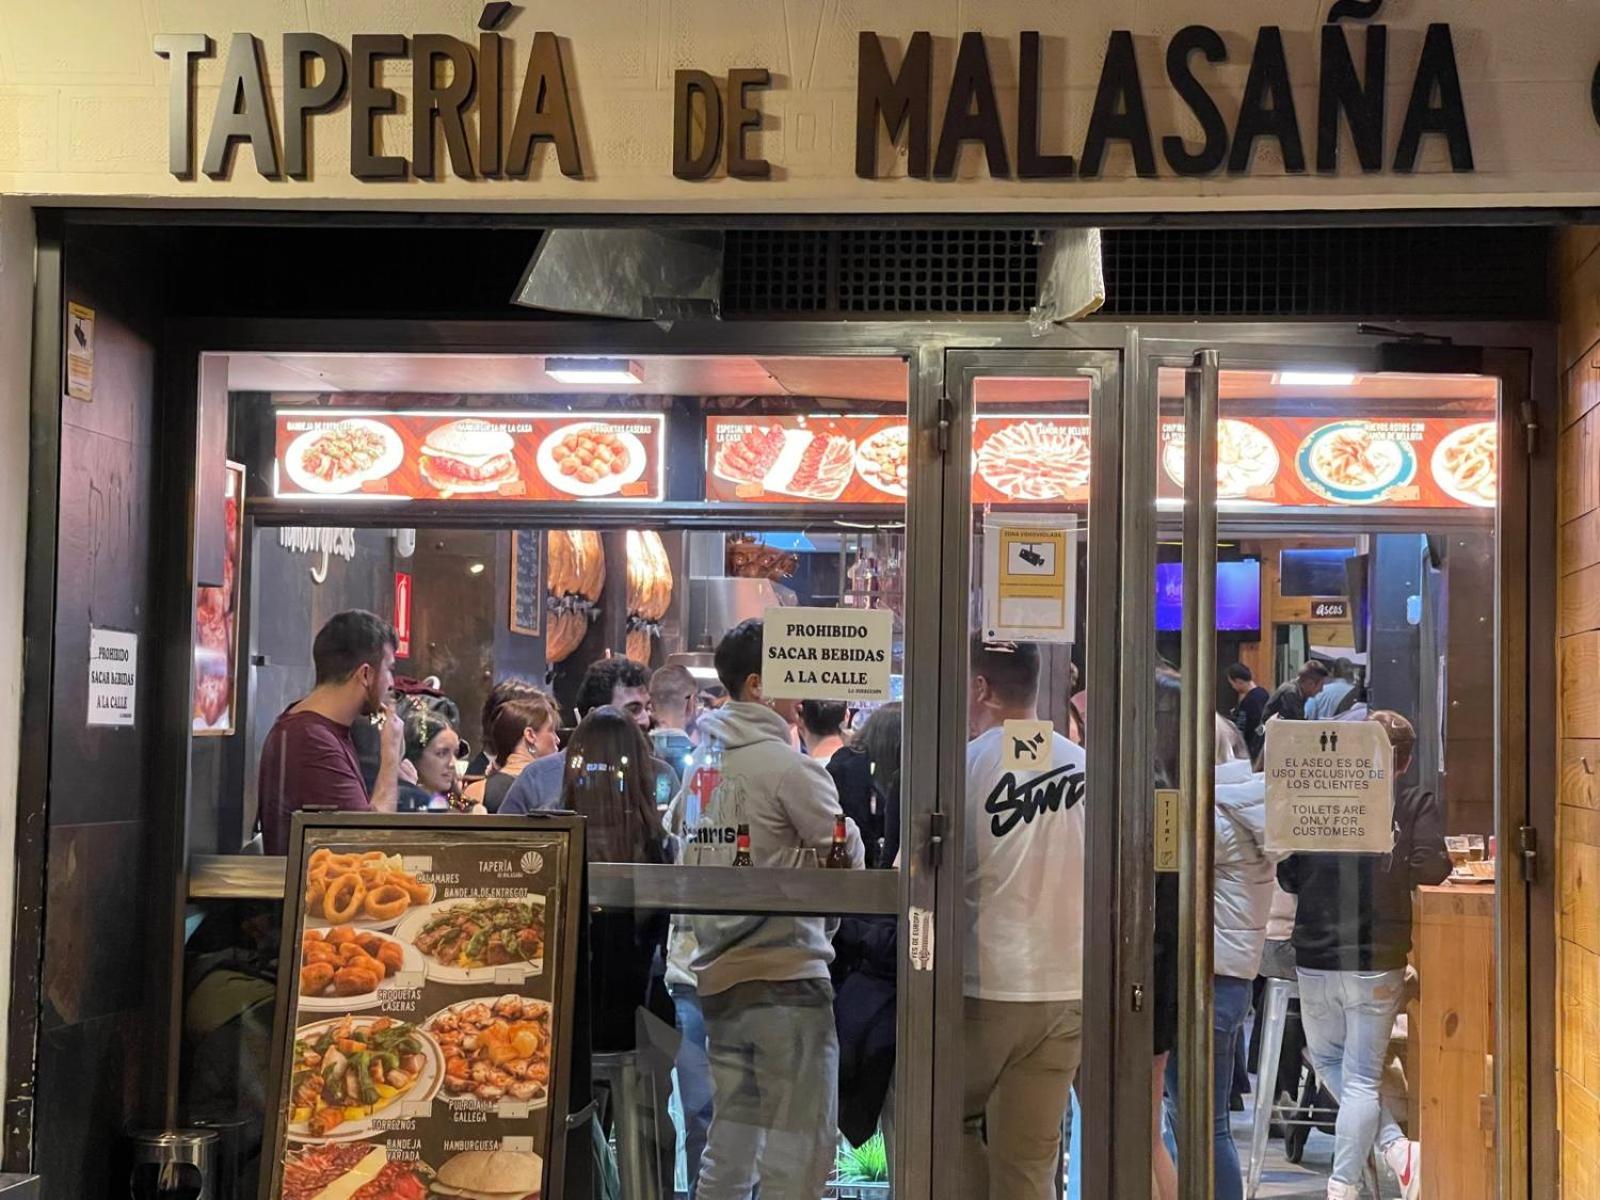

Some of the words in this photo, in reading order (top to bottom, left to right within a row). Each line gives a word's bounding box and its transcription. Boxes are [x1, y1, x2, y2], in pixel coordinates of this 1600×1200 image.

[154, 1, 588, 181] TAPERÍA
[673, 68, 772, 180] DE
[855, 0, 1475, 180] MALASAÑA
[508, 424, 516, 433] LA
[517, 424, 532, 433] CASA
[786, 624, 868, 638] PROHIBIDO
[98, 646, 129, 662] PROHIBIDO
[768, 646, 818, 660] SACAR
[821, 648, 885, 662] BEBIDAS
[91, 671, 110, 684] SACAR
[111, 672, 134, 686] BEBIDAS
[784, 671, 795, 683] A
[798, 671, 818, 683] LA
[821, 672, 868, 685] CALLE
[102, 695, 110, 708] LA
[110, 696, 128, 709] CALLE
[1285, 758, 1299, 768] EL
[1301, 758, 1333, 768] ASEO
[1337, 759, 1352, 768] ES
[1356, 759, 1371, 769] DE
[1272, 769, 1296, 778] USO
[1301, 769, 1364, 779] EXCLUSIVO
[1369, 770, 1385, 779] DE
[1287, 780, 1310, 790] LOS
[1313, 780, 1369, 790] CLIENTES
[1292, 805, 1341, 815] TOILETS
[1343, 805, 1367, 815] ARE
[1300, 816, 1330, 825] ONLY
[1334, 816, 1358, 826] FOR
[1293, 826, 1365, 837] CUSTOMERS
[478, 859, 512, 873] TAPERÍA
[416, 873, 460, 884] CALAMARES
[444, 887, 479, 898] BANDEJA
[480, 887, 490, 898] DE
[378, 990, 422, 1001] CROQUETAS
[382, 1001, 416, 1012] CASERAS
[453, 1111, 487, 1122] GALLEGA
[371, 1119, 416, 1131] TORREZNOS
[386, 1139, 421, 1150] BANDEJA
[443, 1140, 499, 1151] HAMBURGUESA
[386, 1150, 420, 1161] VARIADA
